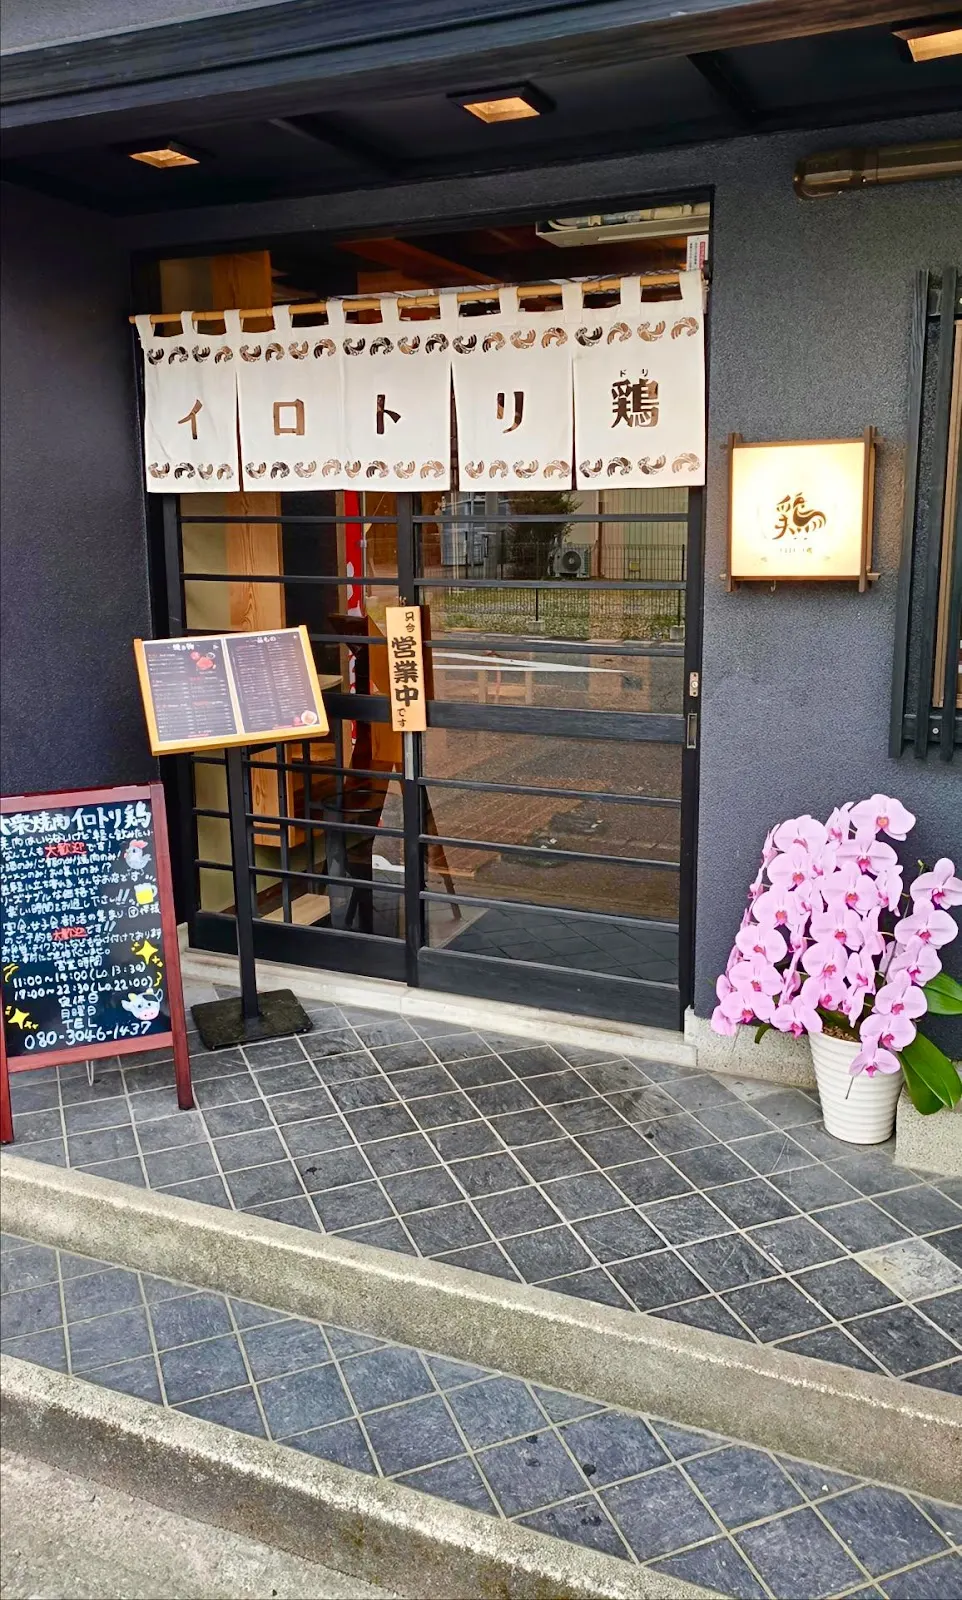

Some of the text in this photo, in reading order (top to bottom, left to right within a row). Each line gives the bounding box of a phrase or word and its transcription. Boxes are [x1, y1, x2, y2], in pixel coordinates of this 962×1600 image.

[54, 955, 102, 971] 営業時間
[58, 992, 99, 1007] 定休日
[24, 1021, 152, 1050] 080-3046-1437
